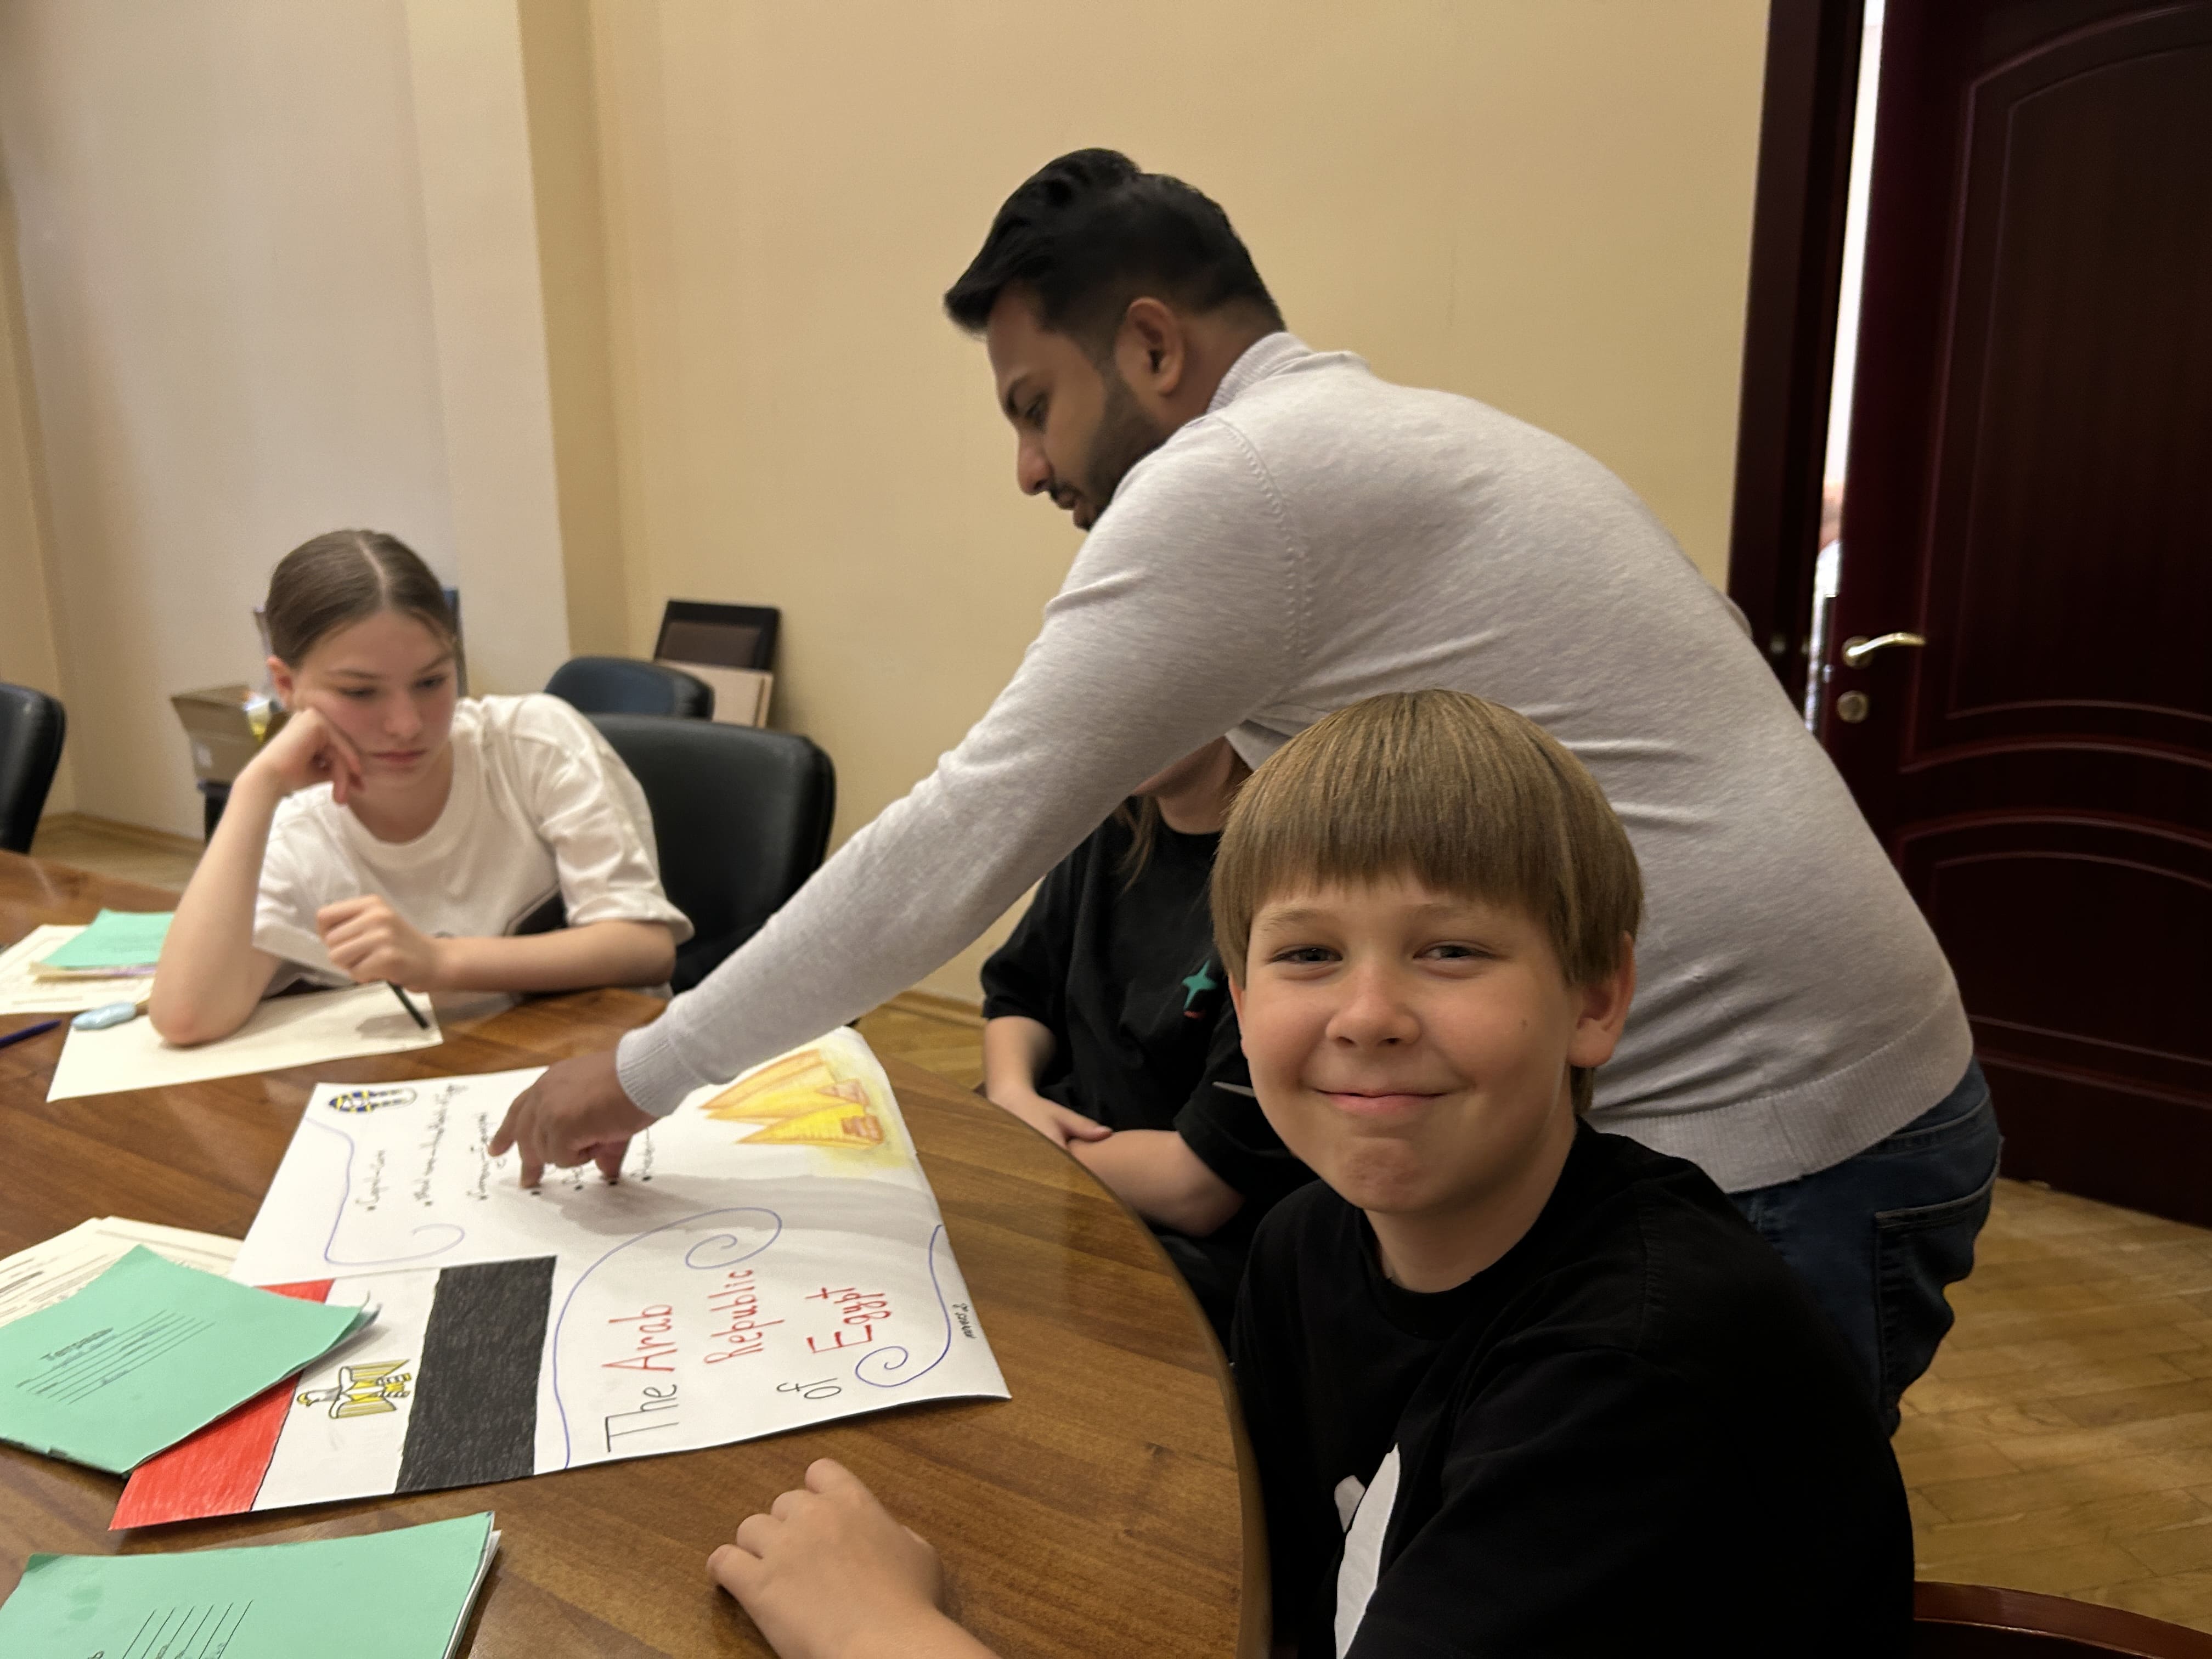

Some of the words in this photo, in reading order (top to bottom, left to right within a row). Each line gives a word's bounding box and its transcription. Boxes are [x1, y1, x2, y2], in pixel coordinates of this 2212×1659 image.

[602, 1304, 676, 1372] Arab
[703, 1269, 785, 1364] Republic
[805, 1286, 893, 1354] Egypt
[605, 1383, 679, 1453] The
[776, 1376, 842, 1400] of
